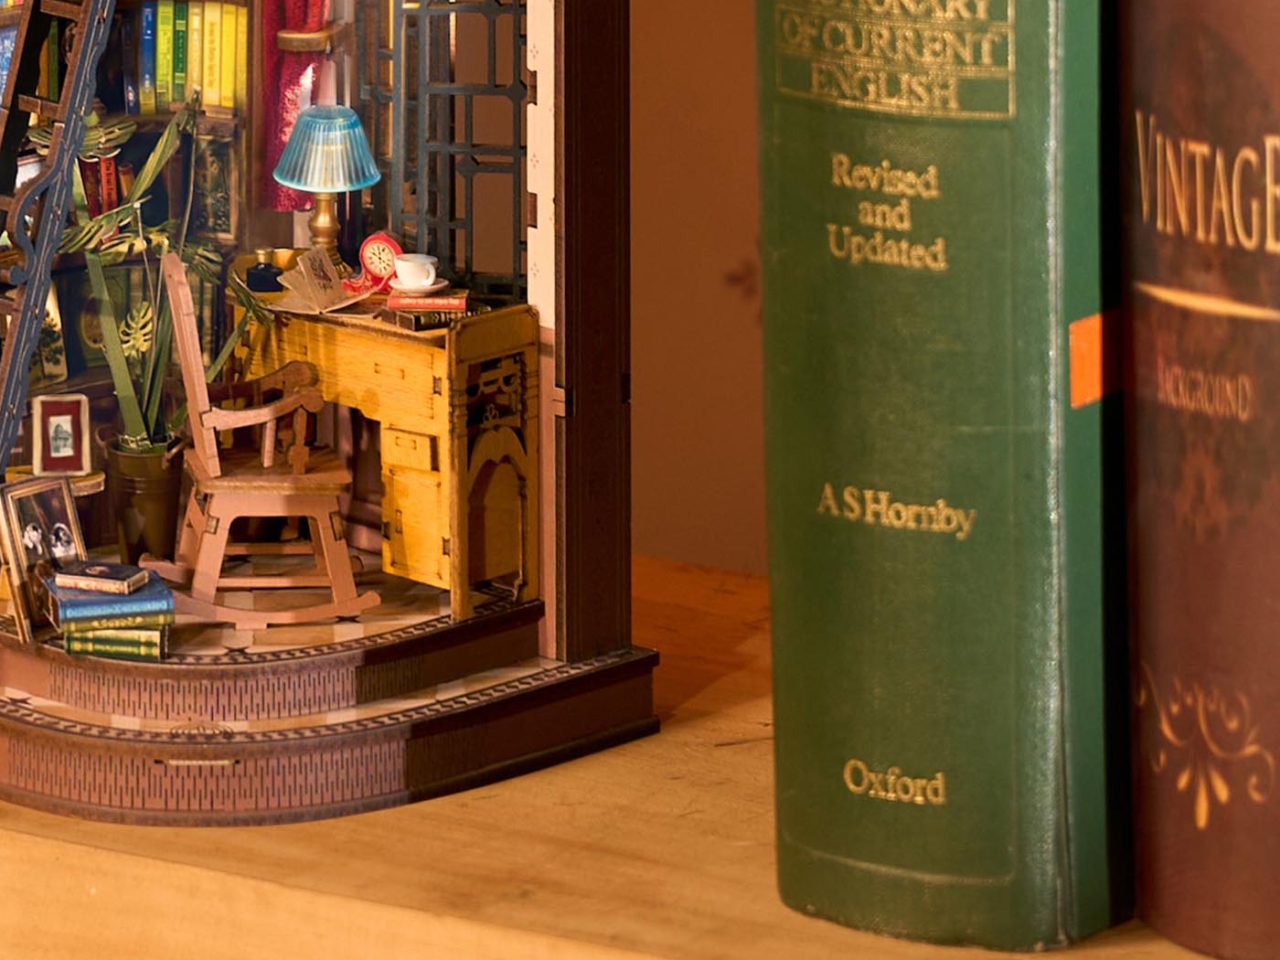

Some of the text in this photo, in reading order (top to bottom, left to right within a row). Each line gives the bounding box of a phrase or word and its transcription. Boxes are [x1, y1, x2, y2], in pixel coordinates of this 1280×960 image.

[782, 12, 1003, 65] OF CURRENT
[810, 61, 962, 110] ENGLISH
[831, 152, 941, 200] Revised
[1135, 109, 1280, 254] VINTAGE
[858, 198, 912, 232] and
[827, 222, 949, 272] Updated
[818, 482, 976, 540] A S Hornby
[843, 757, 946, 806] Oxford
